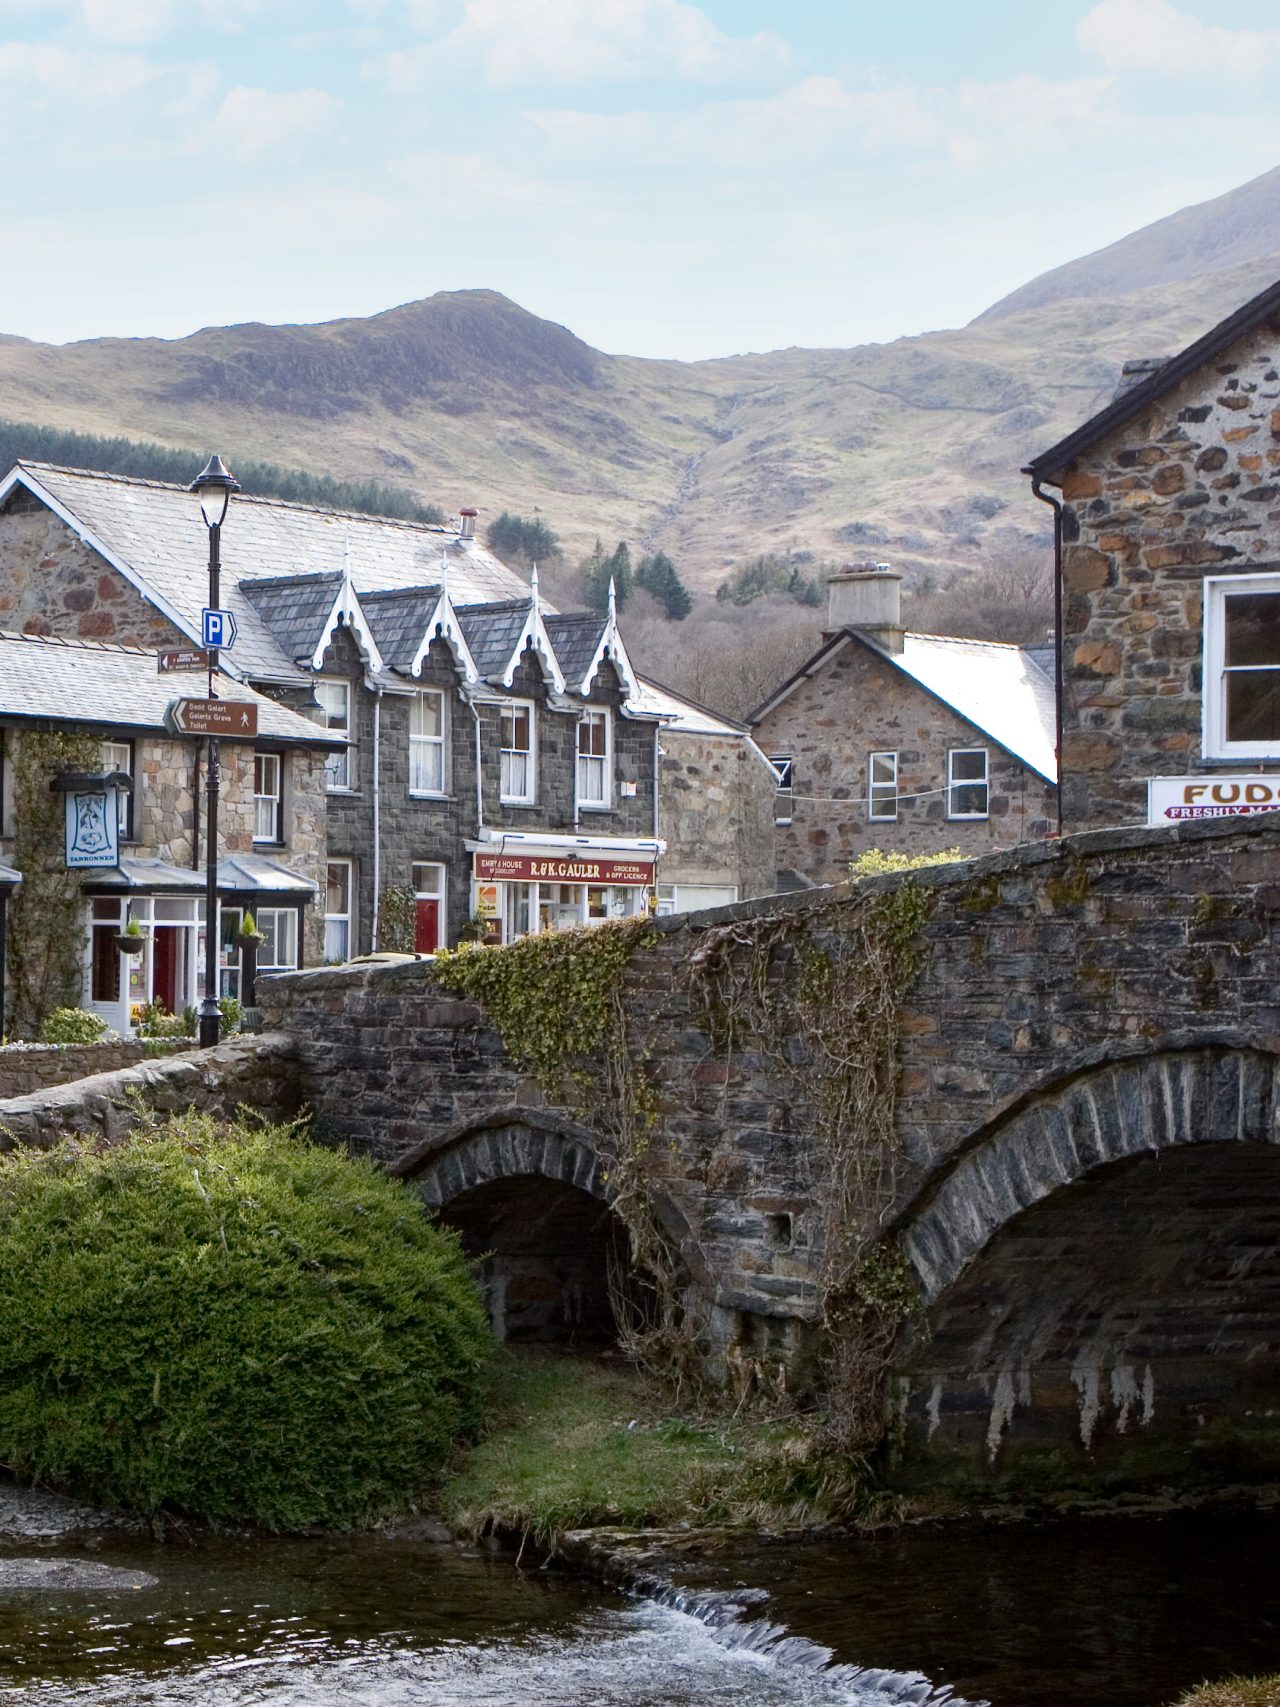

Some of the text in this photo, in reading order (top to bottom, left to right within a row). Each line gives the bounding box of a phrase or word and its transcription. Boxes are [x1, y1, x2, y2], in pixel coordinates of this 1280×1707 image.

[208, 615, 221, 641] P
[189, 703, 205, 711] Bedd
[189, 712, 232, 722] Gelerts Grave
[1184, 784, 1280, 804] FUD
[1171, 807, 1242, 817] FRESHLY
